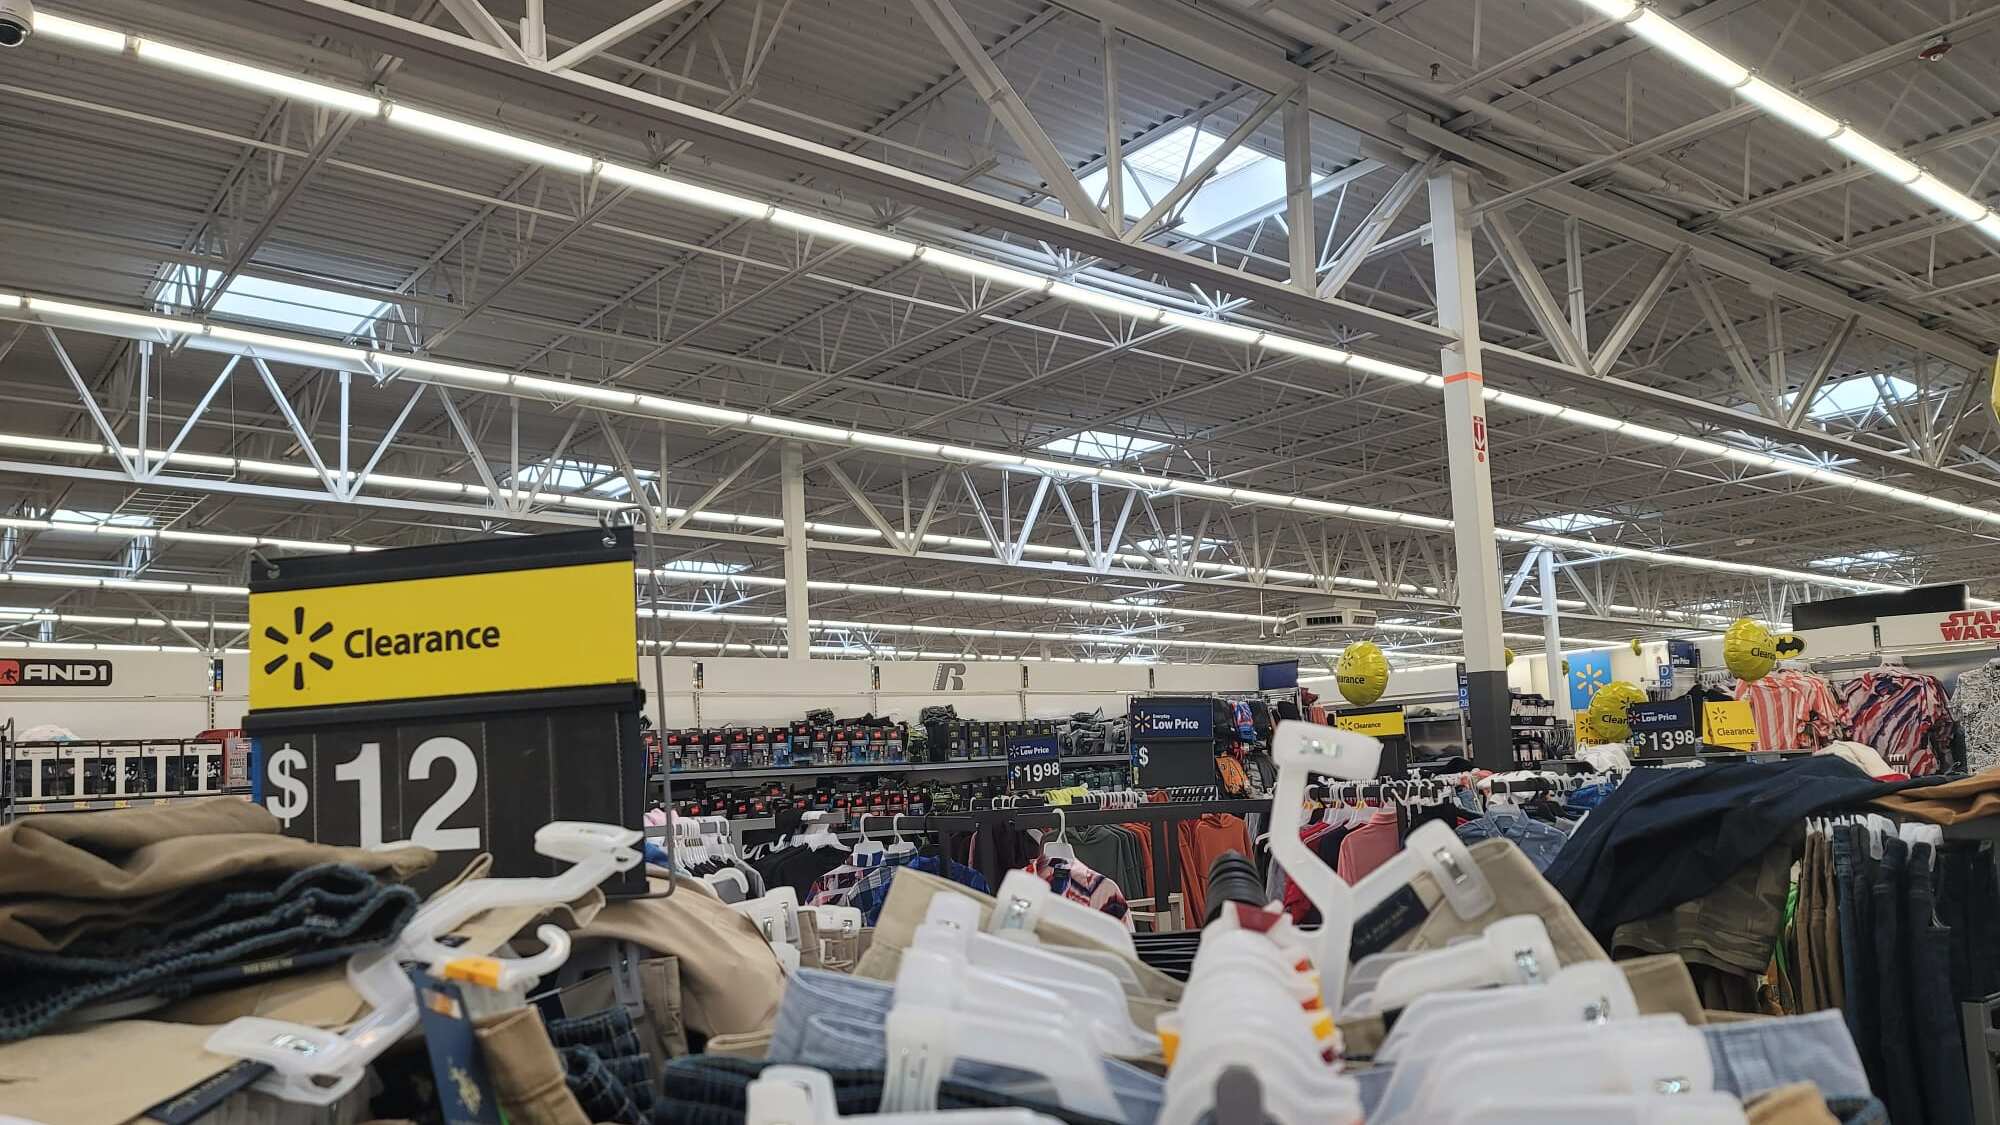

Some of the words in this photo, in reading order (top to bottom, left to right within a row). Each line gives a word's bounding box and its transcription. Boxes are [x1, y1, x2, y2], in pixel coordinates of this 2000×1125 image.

[344, 625, 501, 659] Clearance
[24, 664, 107, 680] AND1
[1660, 667, 1669, 676] D
[1460, 688, 1467, 697] D
[1641, 714, 1657, 722] Low
[1658, 713, 1678, 721] Price
[1152, 719, 1173, 730] Low
[1175, 718, 1199, 730] Price
[1353, 721, 1382, 729] Clearance
[1717, 727, 1756, 736] Clearance
[1020, 748, 1033, 756] Low
[1033, 746, 1049, 754] Price
[1139, 747, 1149, 767] $
